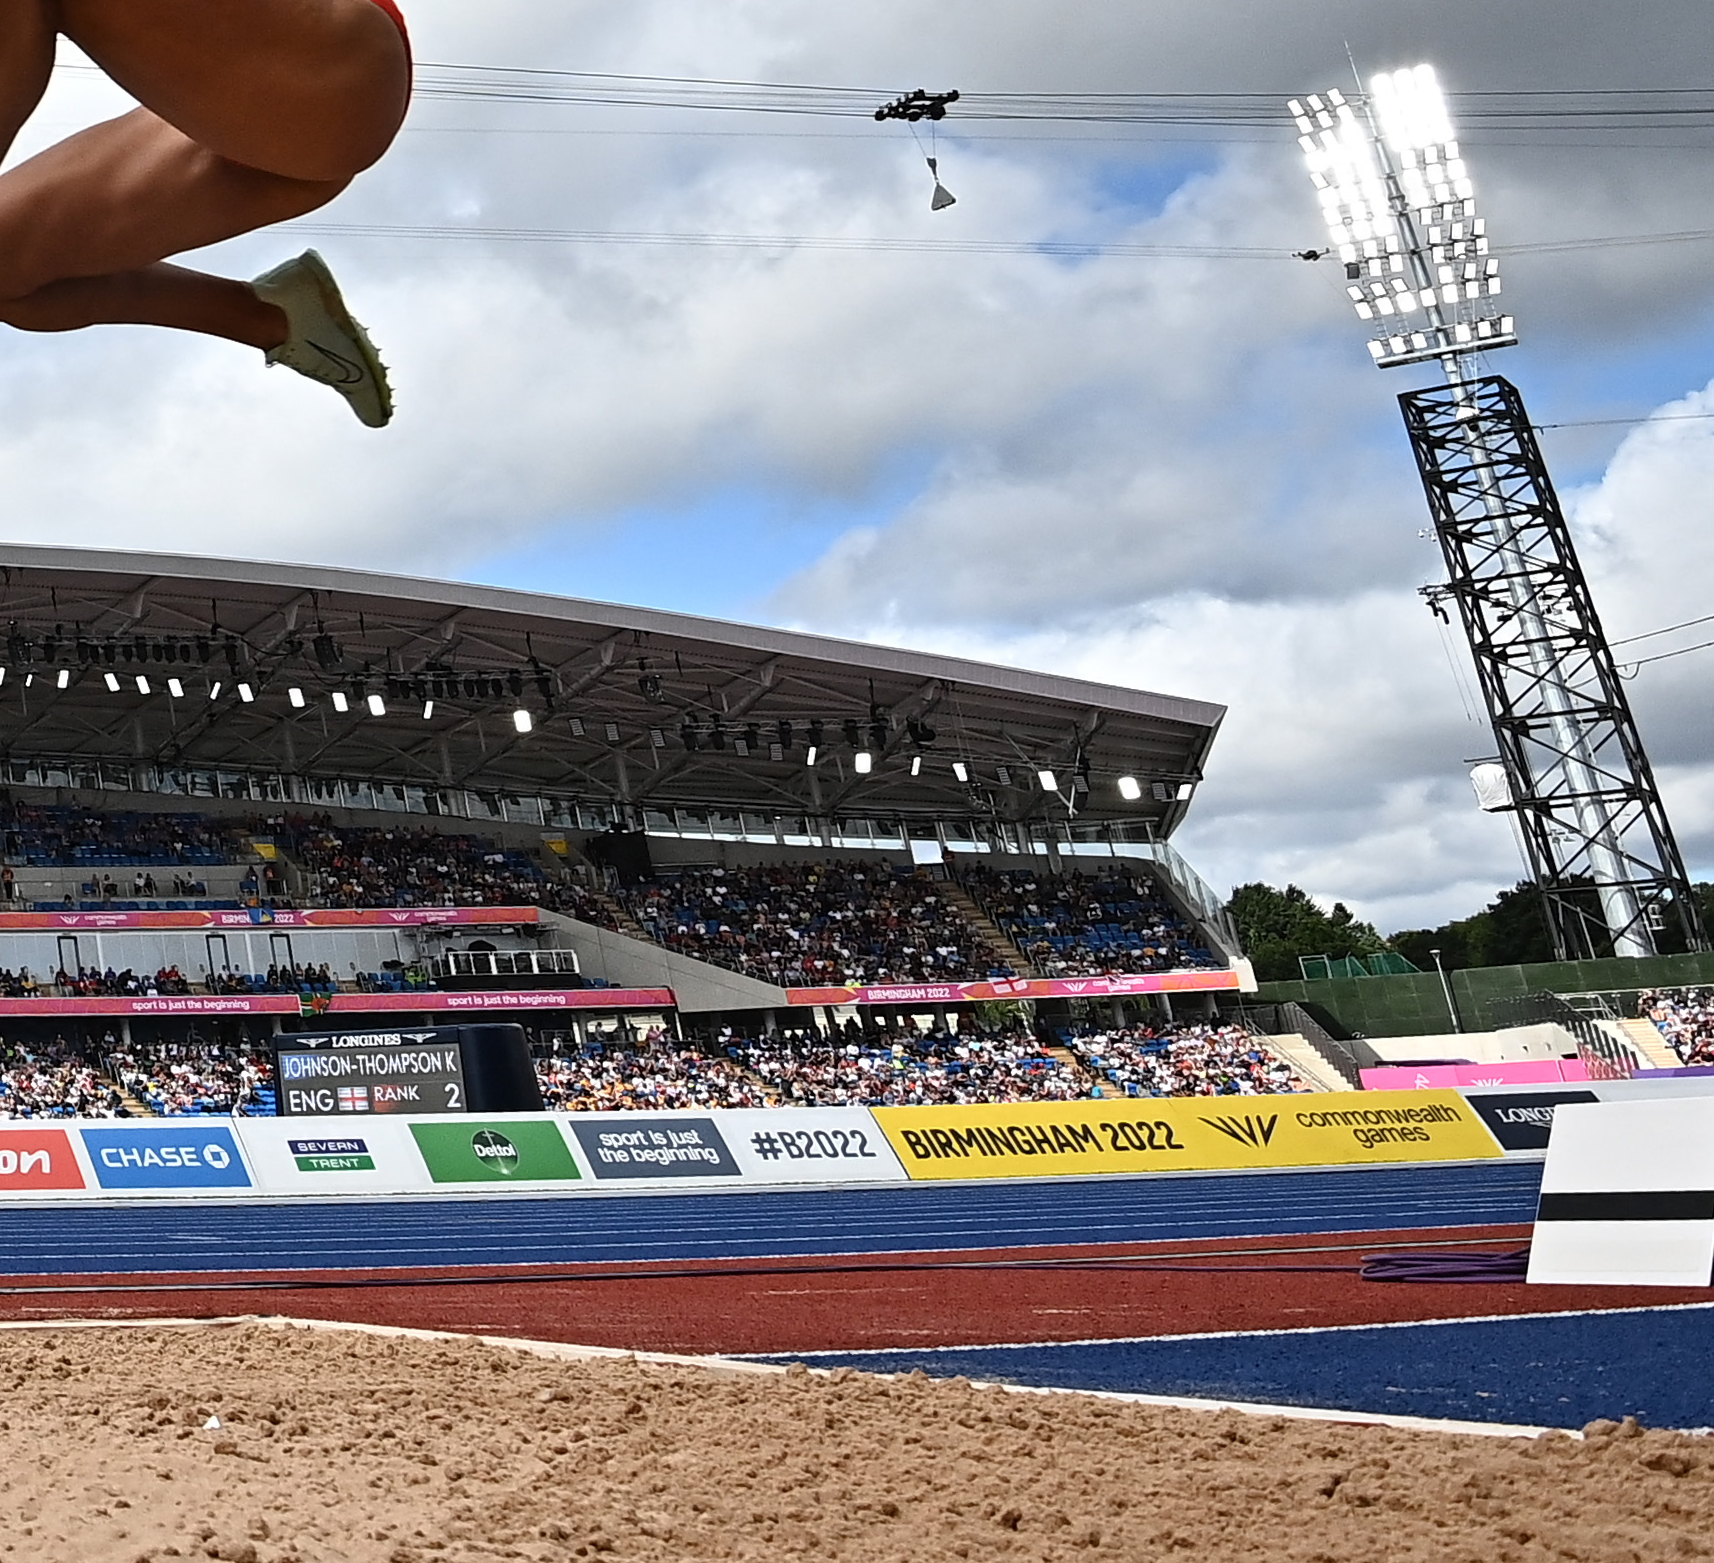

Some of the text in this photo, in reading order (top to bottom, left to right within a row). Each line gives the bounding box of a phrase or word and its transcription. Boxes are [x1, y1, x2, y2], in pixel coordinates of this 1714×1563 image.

[273, 913, 294, 924] 2022
[446, 993, 566, 1006] sport is just the beginning
[868, 987, 950, 1000] BIRMINGHAM 2022
[132, 998, 250, 1010] sport is just the beginning
[331, 1033, 401, 1048] LONGINES
[283, 1051, 458, 1078] JOHNSON-THOMPSON K
[289, 1083, 461, 1112] ENG RANK 2
[1295, 1104, 1462, 1127] commonwealth
[297, 1142, 359, 1152] SEVERN
[598, 1128, 703, 1150] sport is just
[750, 1129, 877, 1161] #B2022
[900, 1121, 1185, 1160] BIRMINGHAM 2022
[1352, 1126, 1431, 1149] games
[100, 1146, 202, 1168] CHASE
[473, 1144, 516, 1157] Dettol
[597, 1146, 720, 1166] the beginning
[309, 1158, 360, 1169] TRENT
